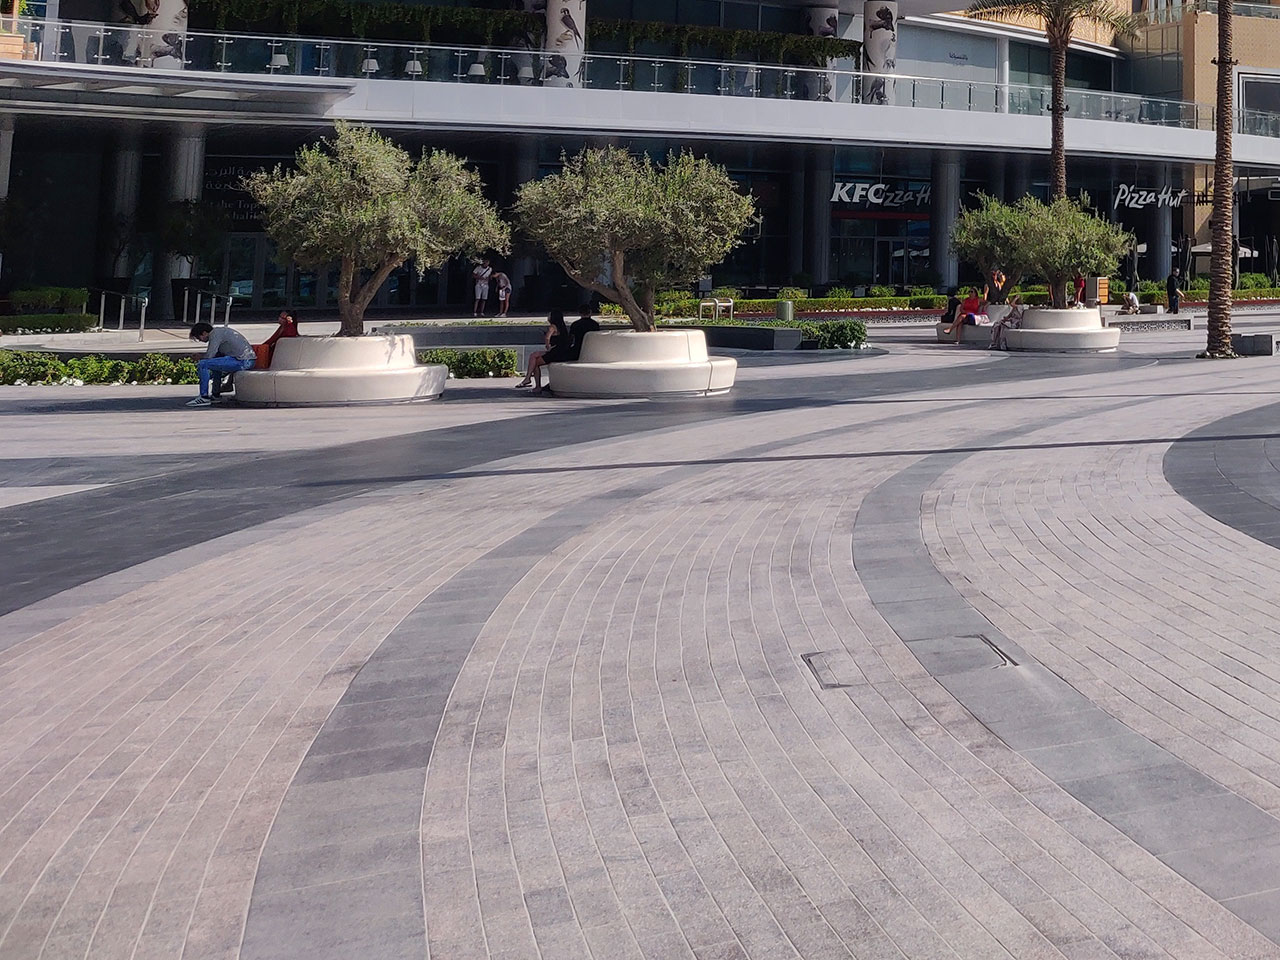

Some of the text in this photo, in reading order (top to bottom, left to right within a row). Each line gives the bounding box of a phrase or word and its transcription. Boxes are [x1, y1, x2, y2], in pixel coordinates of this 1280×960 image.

[830, 182, 885, 204] KFC
[1113, 184, 1156, 209] Pizza
[1157, 185, 1189, 208] Hut
